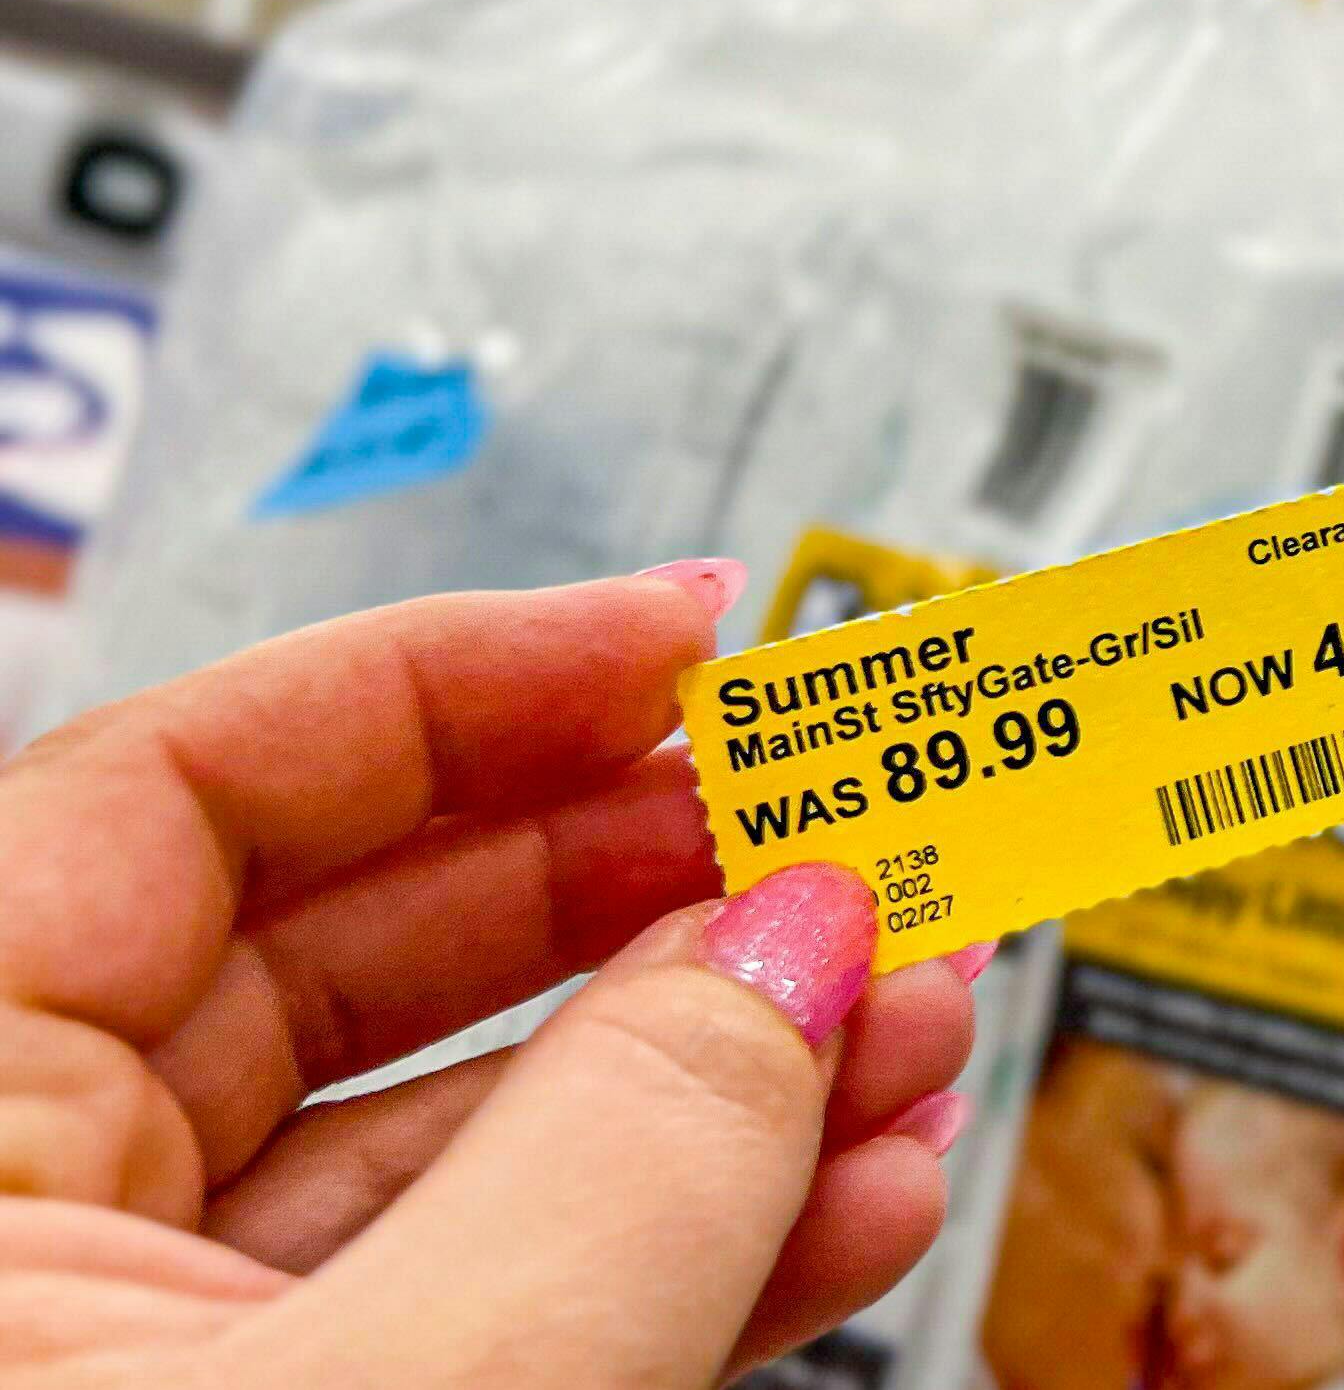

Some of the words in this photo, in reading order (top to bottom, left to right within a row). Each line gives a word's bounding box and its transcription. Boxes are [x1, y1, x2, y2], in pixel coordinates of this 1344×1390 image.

[718, 622, 976, 728] Summer
[725, 701, 882, 774] MainSt
[891, 608, 1206, 725] SftyGate-Gr/Sil
[1170, 649, 1294, 722] NOW
[735, 777, 869, 848] WAS
[881, 698, 1082, 803] 89.99
[876, 844, 940, 881] 2138
[886, 873, 934, 904] 002
[887, 895, 954, 933] 02/27
